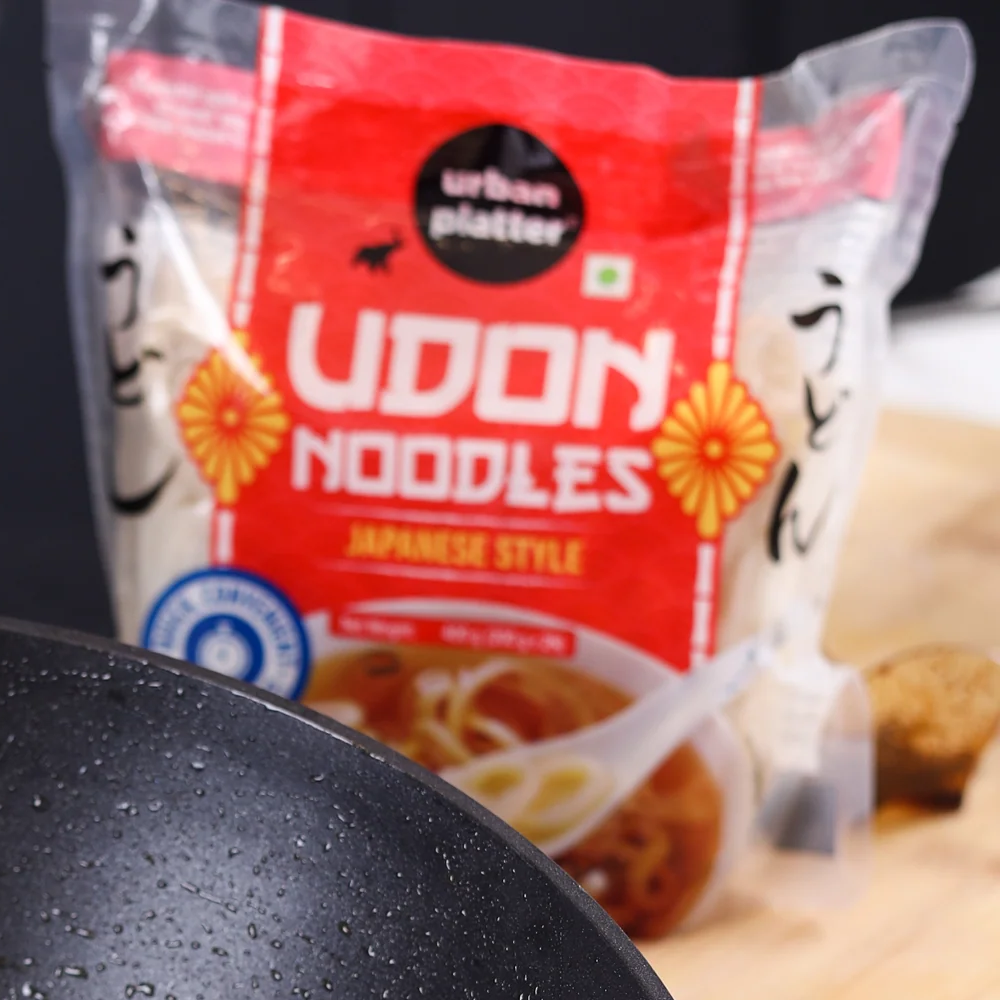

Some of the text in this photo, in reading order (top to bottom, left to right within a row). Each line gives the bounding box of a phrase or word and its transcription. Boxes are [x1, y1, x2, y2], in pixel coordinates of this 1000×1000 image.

[429, 202, 565, 246] platter
[441, 167, 560, 209] urban
[286, 302, 676, 432] UDON
[767, 268, 851, 563] うどん
[290, 424, 654, 514] NOODLES
[346, 520, 582, 576] JAPANESE STYLE
